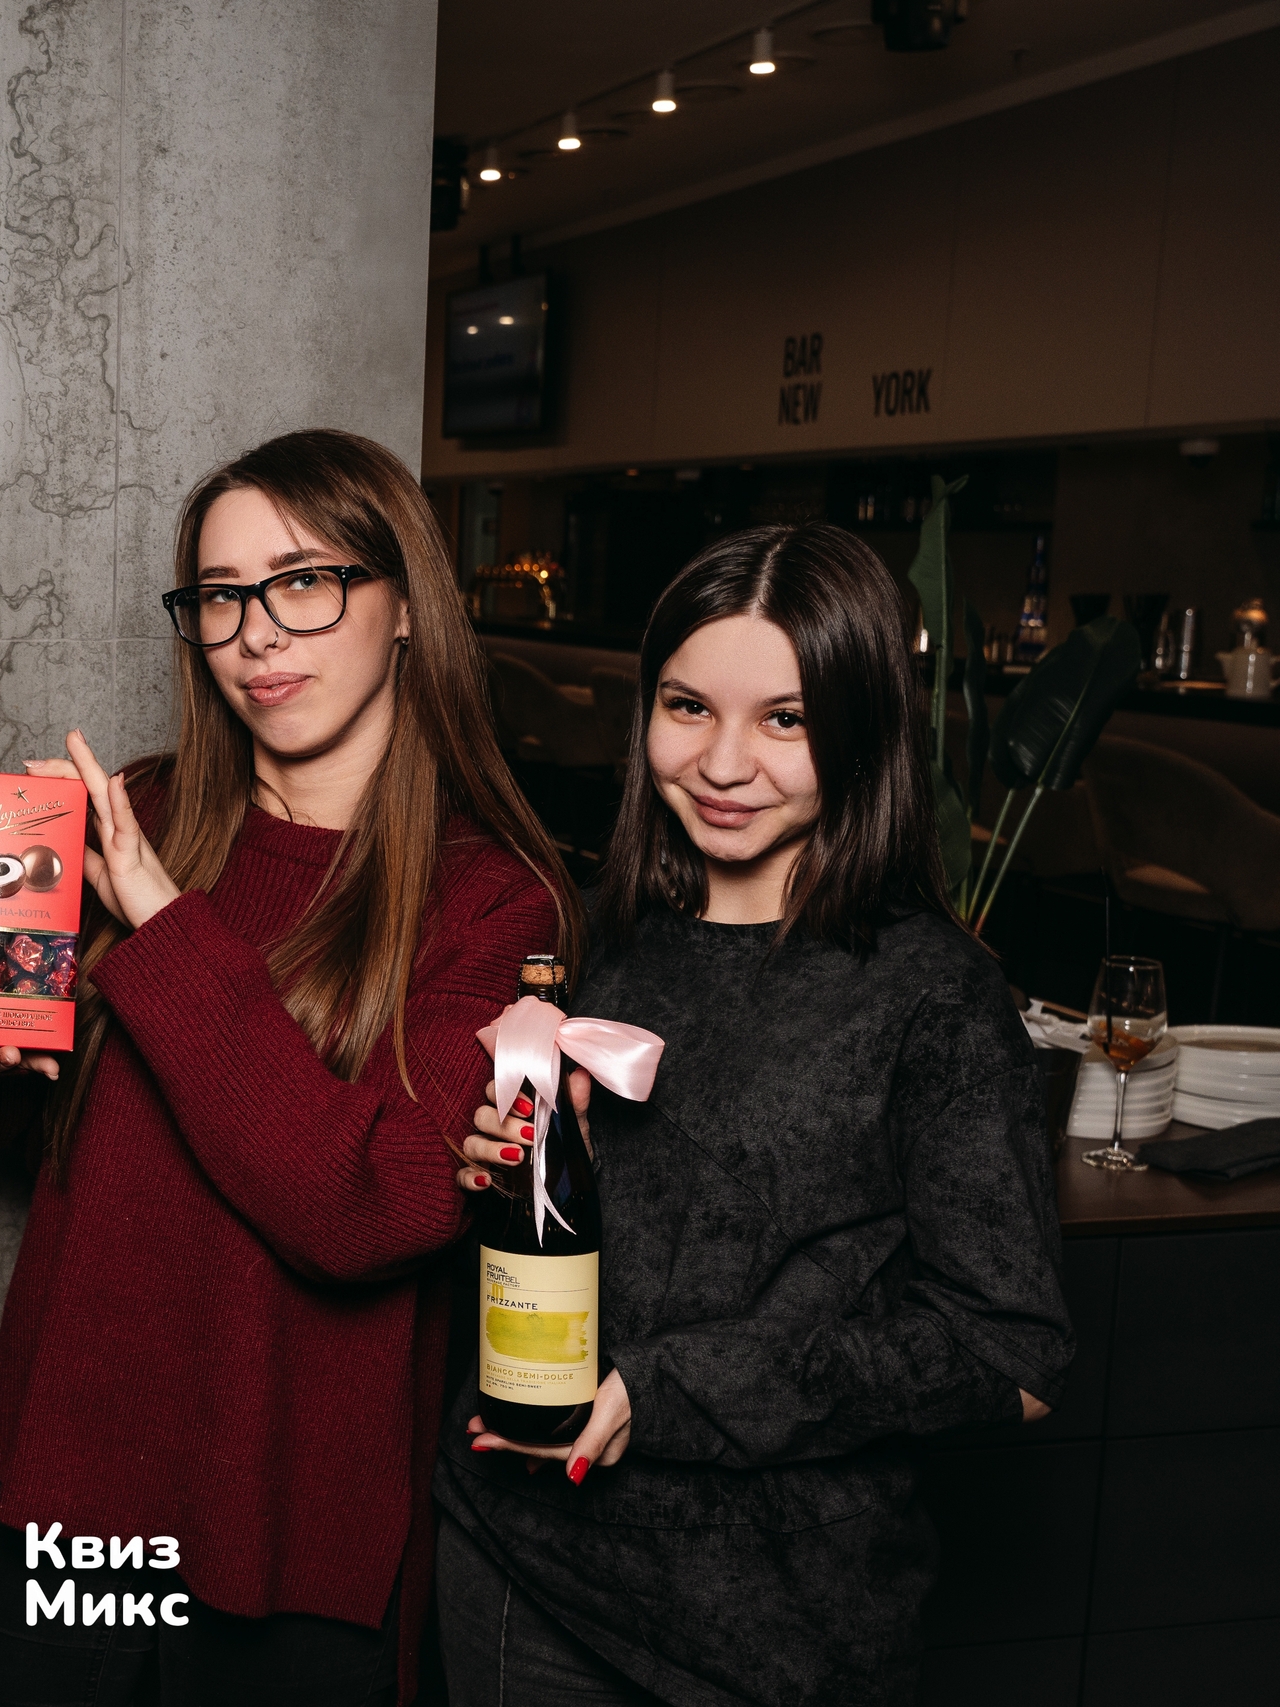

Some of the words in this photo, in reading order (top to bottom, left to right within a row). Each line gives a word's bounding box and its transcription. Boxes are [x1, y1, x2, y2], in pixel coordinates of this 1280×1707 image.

[783, 331, 823, 378] BAR
[778, 382, 823, 426] NEW
[872, 366, 933, 417] YORK
[486, 1262, 508, 1274] ROYAL
[486, 1294, 538, 1310] FRIZZANTE
[486, 1363, 514, 1376] BIANCO
[517, 1371, 574, 1380] SEMI-DOLCE
